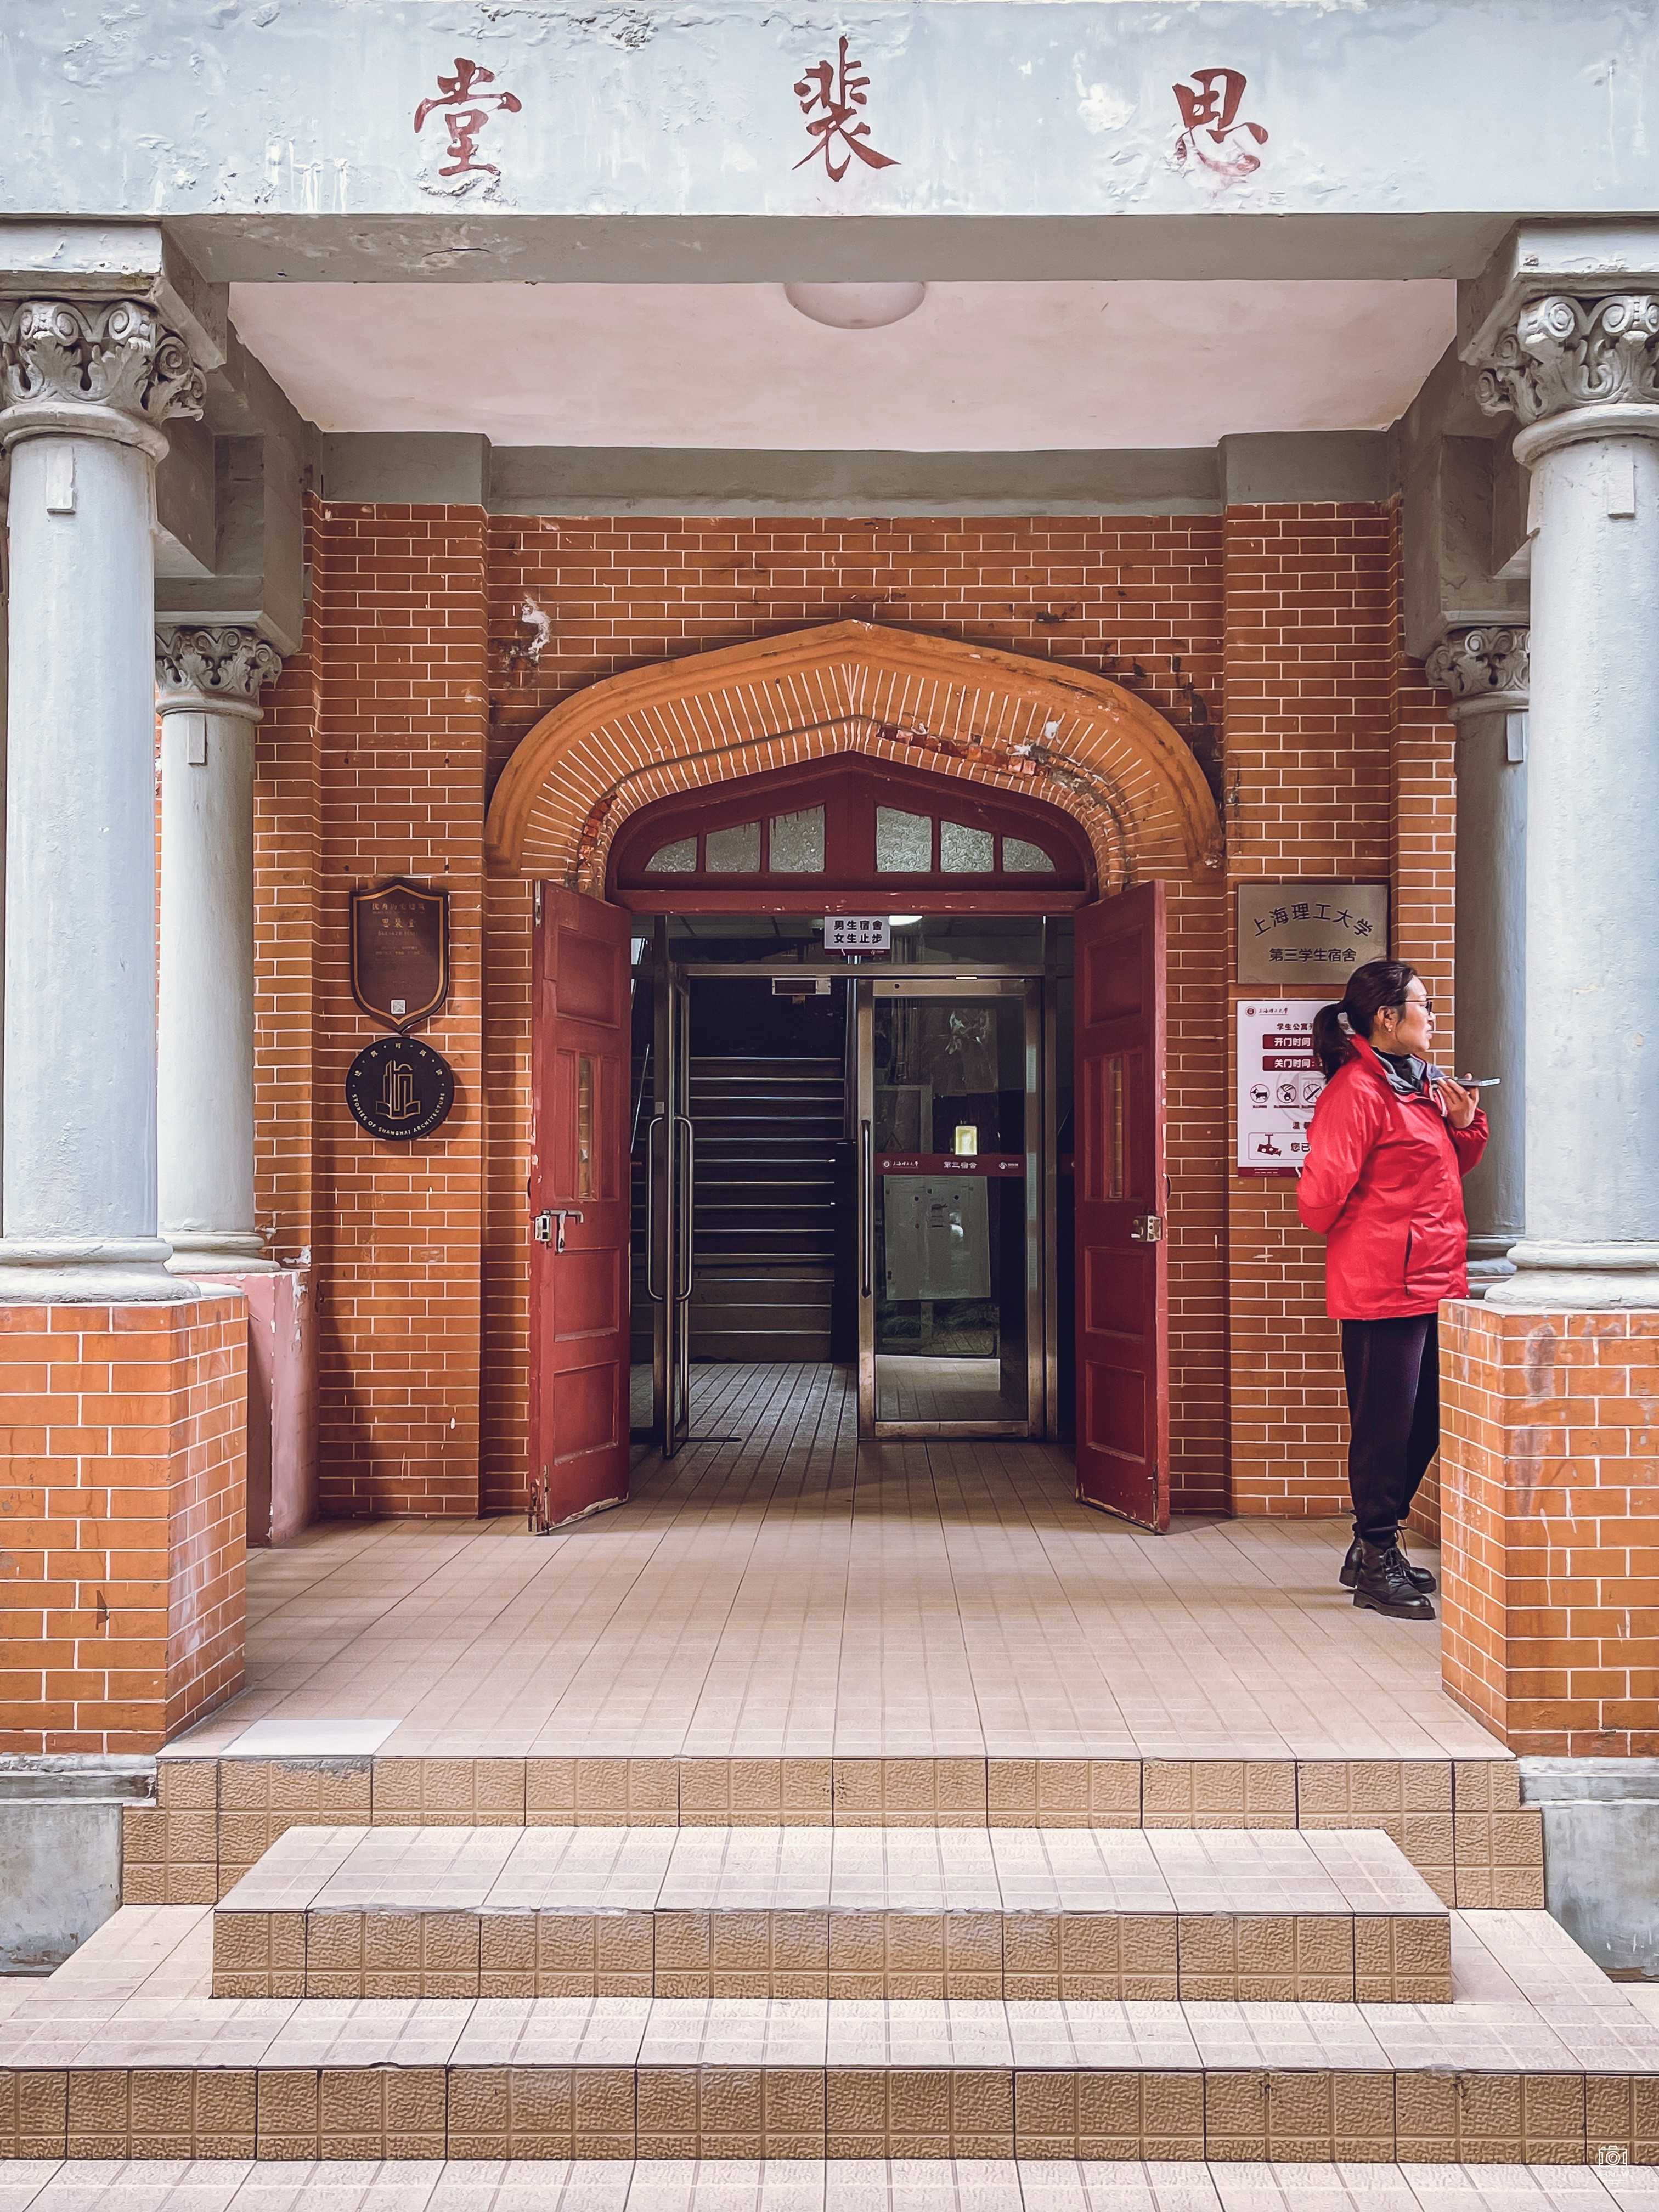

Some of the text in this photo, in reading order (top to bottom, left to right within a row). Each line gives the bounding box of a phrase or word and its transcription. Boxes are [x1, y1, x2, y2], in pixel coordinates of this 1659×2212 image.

[834, 920, 883, 930] 男生宿舍
[1253, 901, 1373, 937] 上海理工大学
[834, 933, 882, 944] 女生止步
[1269, 947, 1357, 962] 第三学生宿舍
[1274, 1037, 1311, 1047] 开门时间
[352, 1093, 368, 1121] STORIES
[377, 1126, 411, 1136] SHANGHAI
[413, 1092, 445, 1133] ARCHITECTURE
